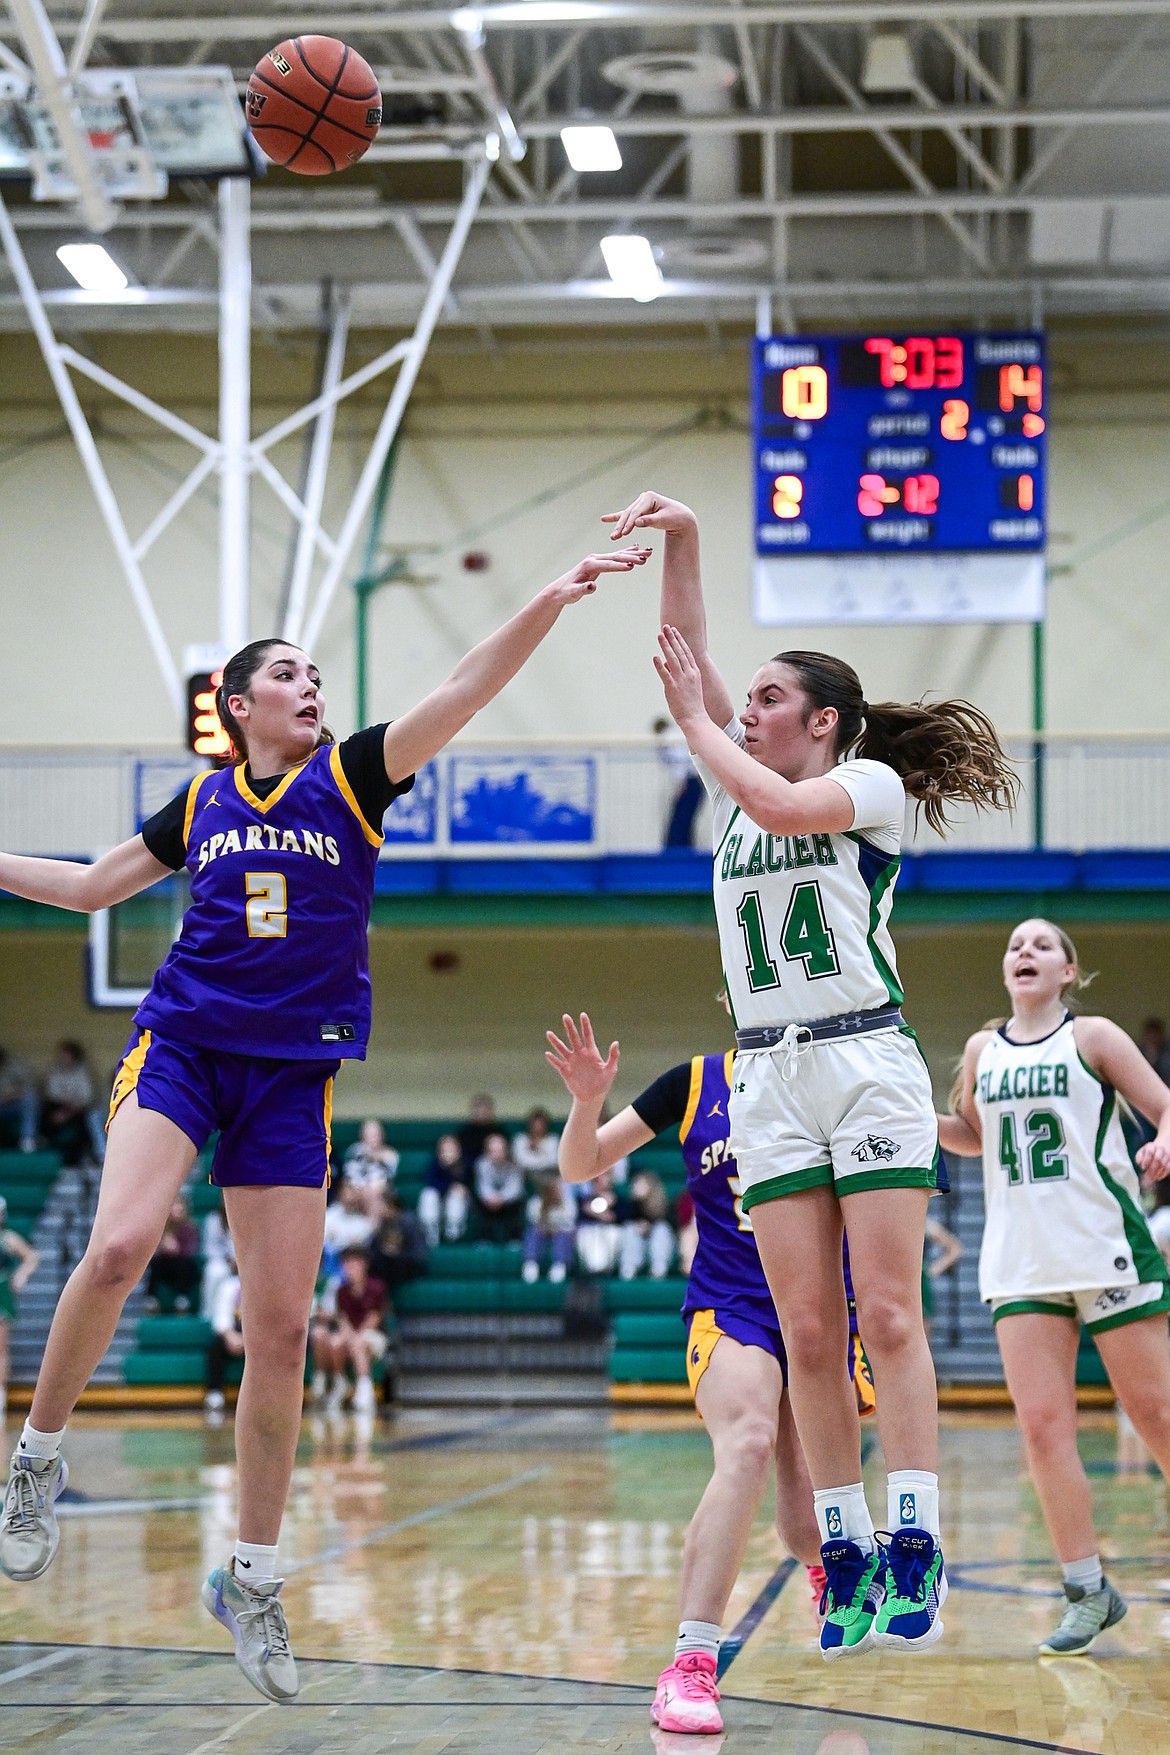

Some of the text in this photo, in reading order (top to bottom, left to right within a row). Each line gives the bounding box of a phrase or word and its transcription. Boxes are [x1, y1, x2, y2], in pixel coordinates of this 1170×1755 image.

[864, 337, 963, 389] 7:03
[941, 399, 969, 440] 2
[773, 475, 802, 518] 2
[1018, 474, 1034, 511] 1
[198, 823, 341, 872] SPARTANS
[722, 832, 839, 882] GLACIER
[245, 872, 287, 938] 2
[736, 880, 841, 994] 14
[980, 1063, 1069, 1104] GLACIER
[998, 1107, 1069, 1187] 42
